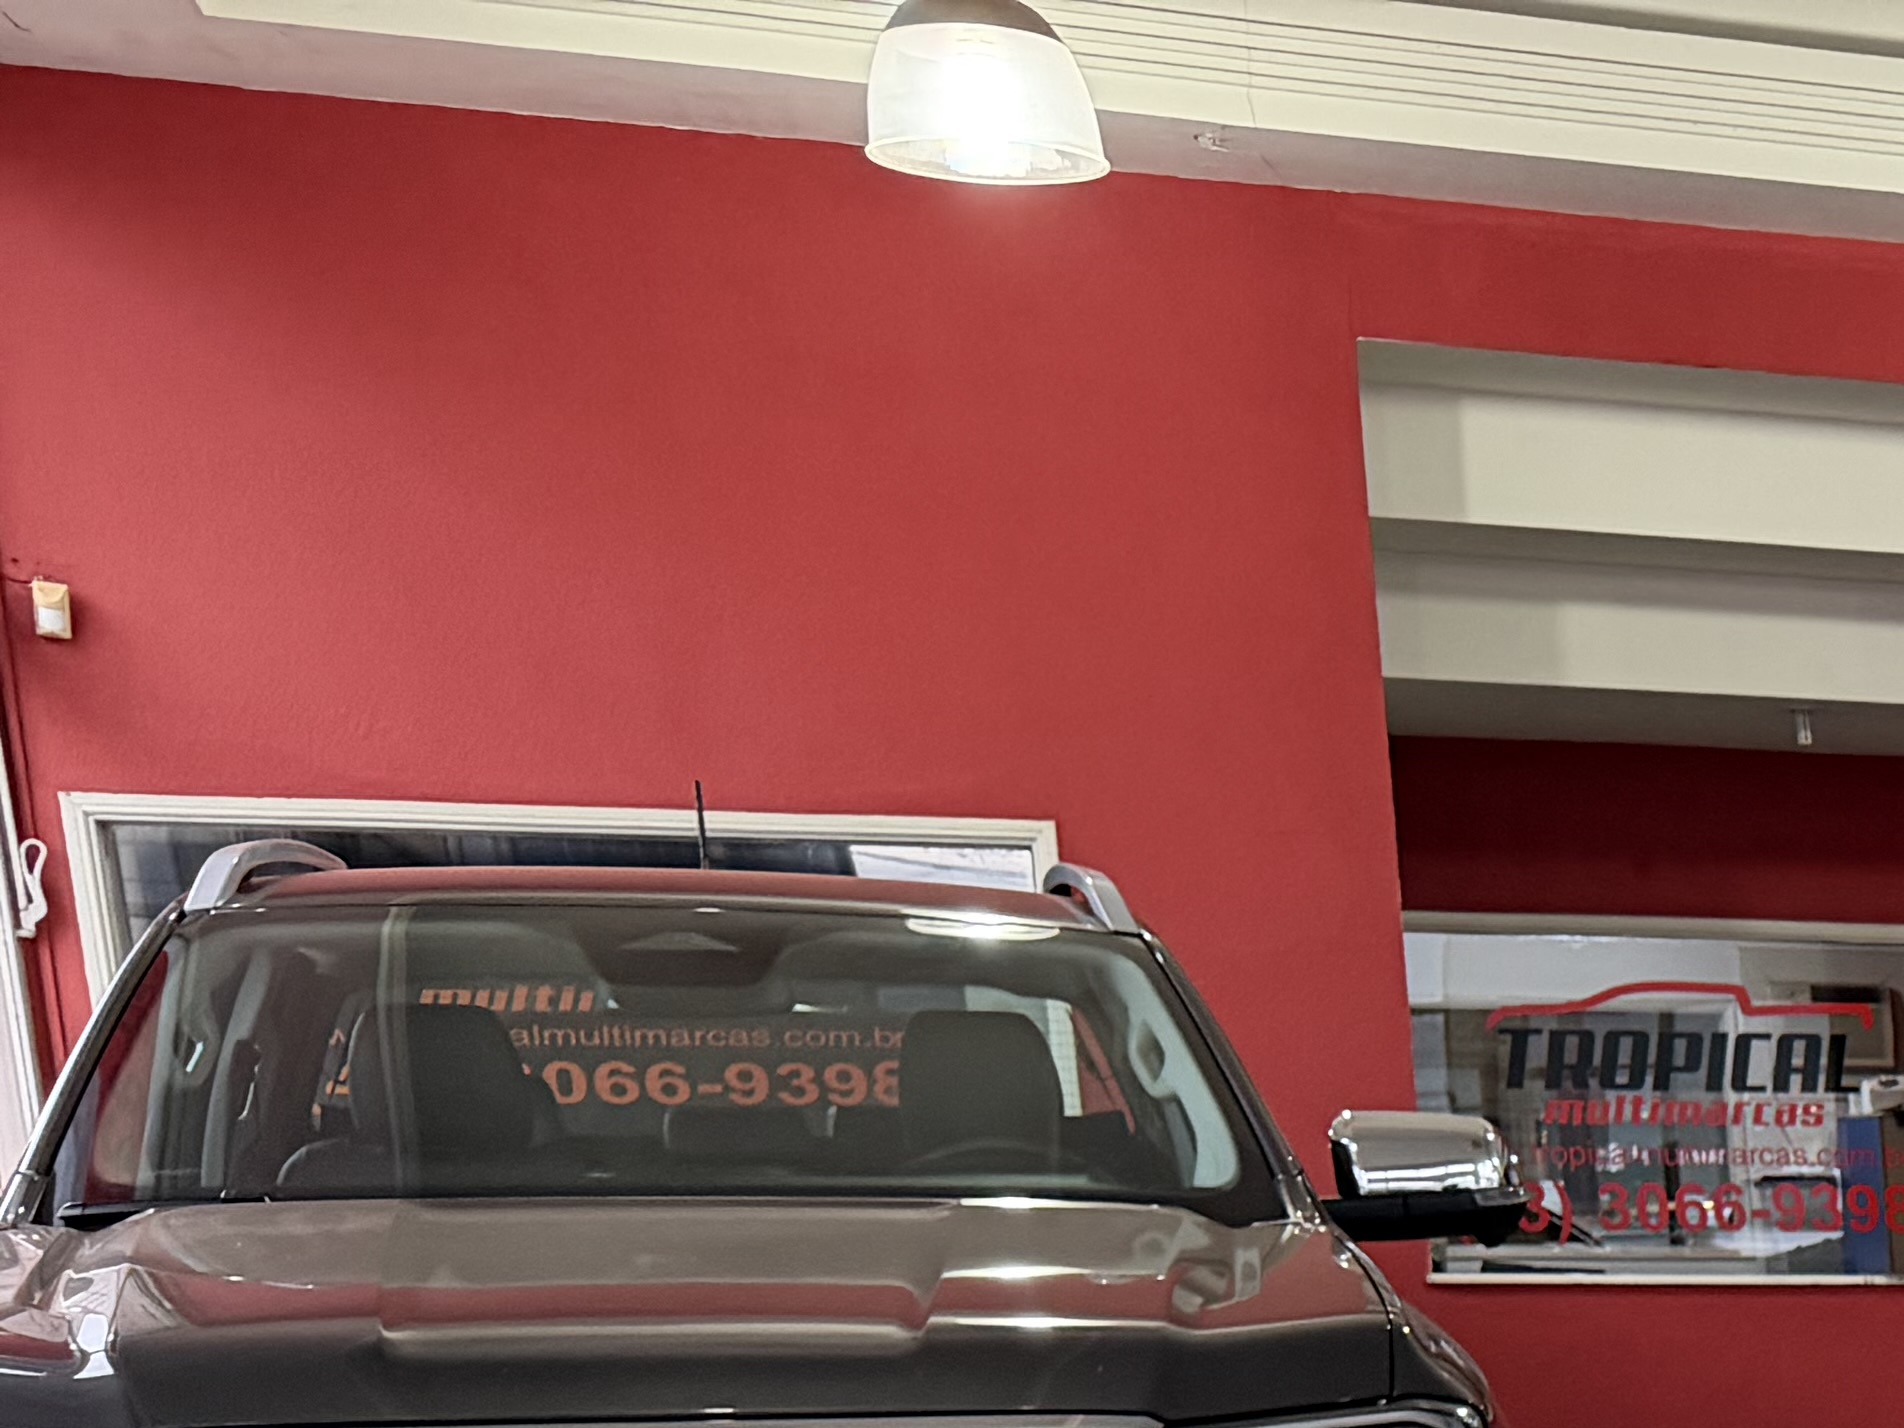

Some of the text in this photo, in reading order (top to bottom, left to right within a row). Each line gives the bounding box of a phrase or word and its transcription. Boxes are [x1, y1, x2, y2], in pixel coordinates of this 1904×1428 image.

[522, 1060, 900, 1107] 066-9398
[1498, 1027, 1860, 1094] TROPICAL
[1543, 1094, 1825, 1127] multimarcas
